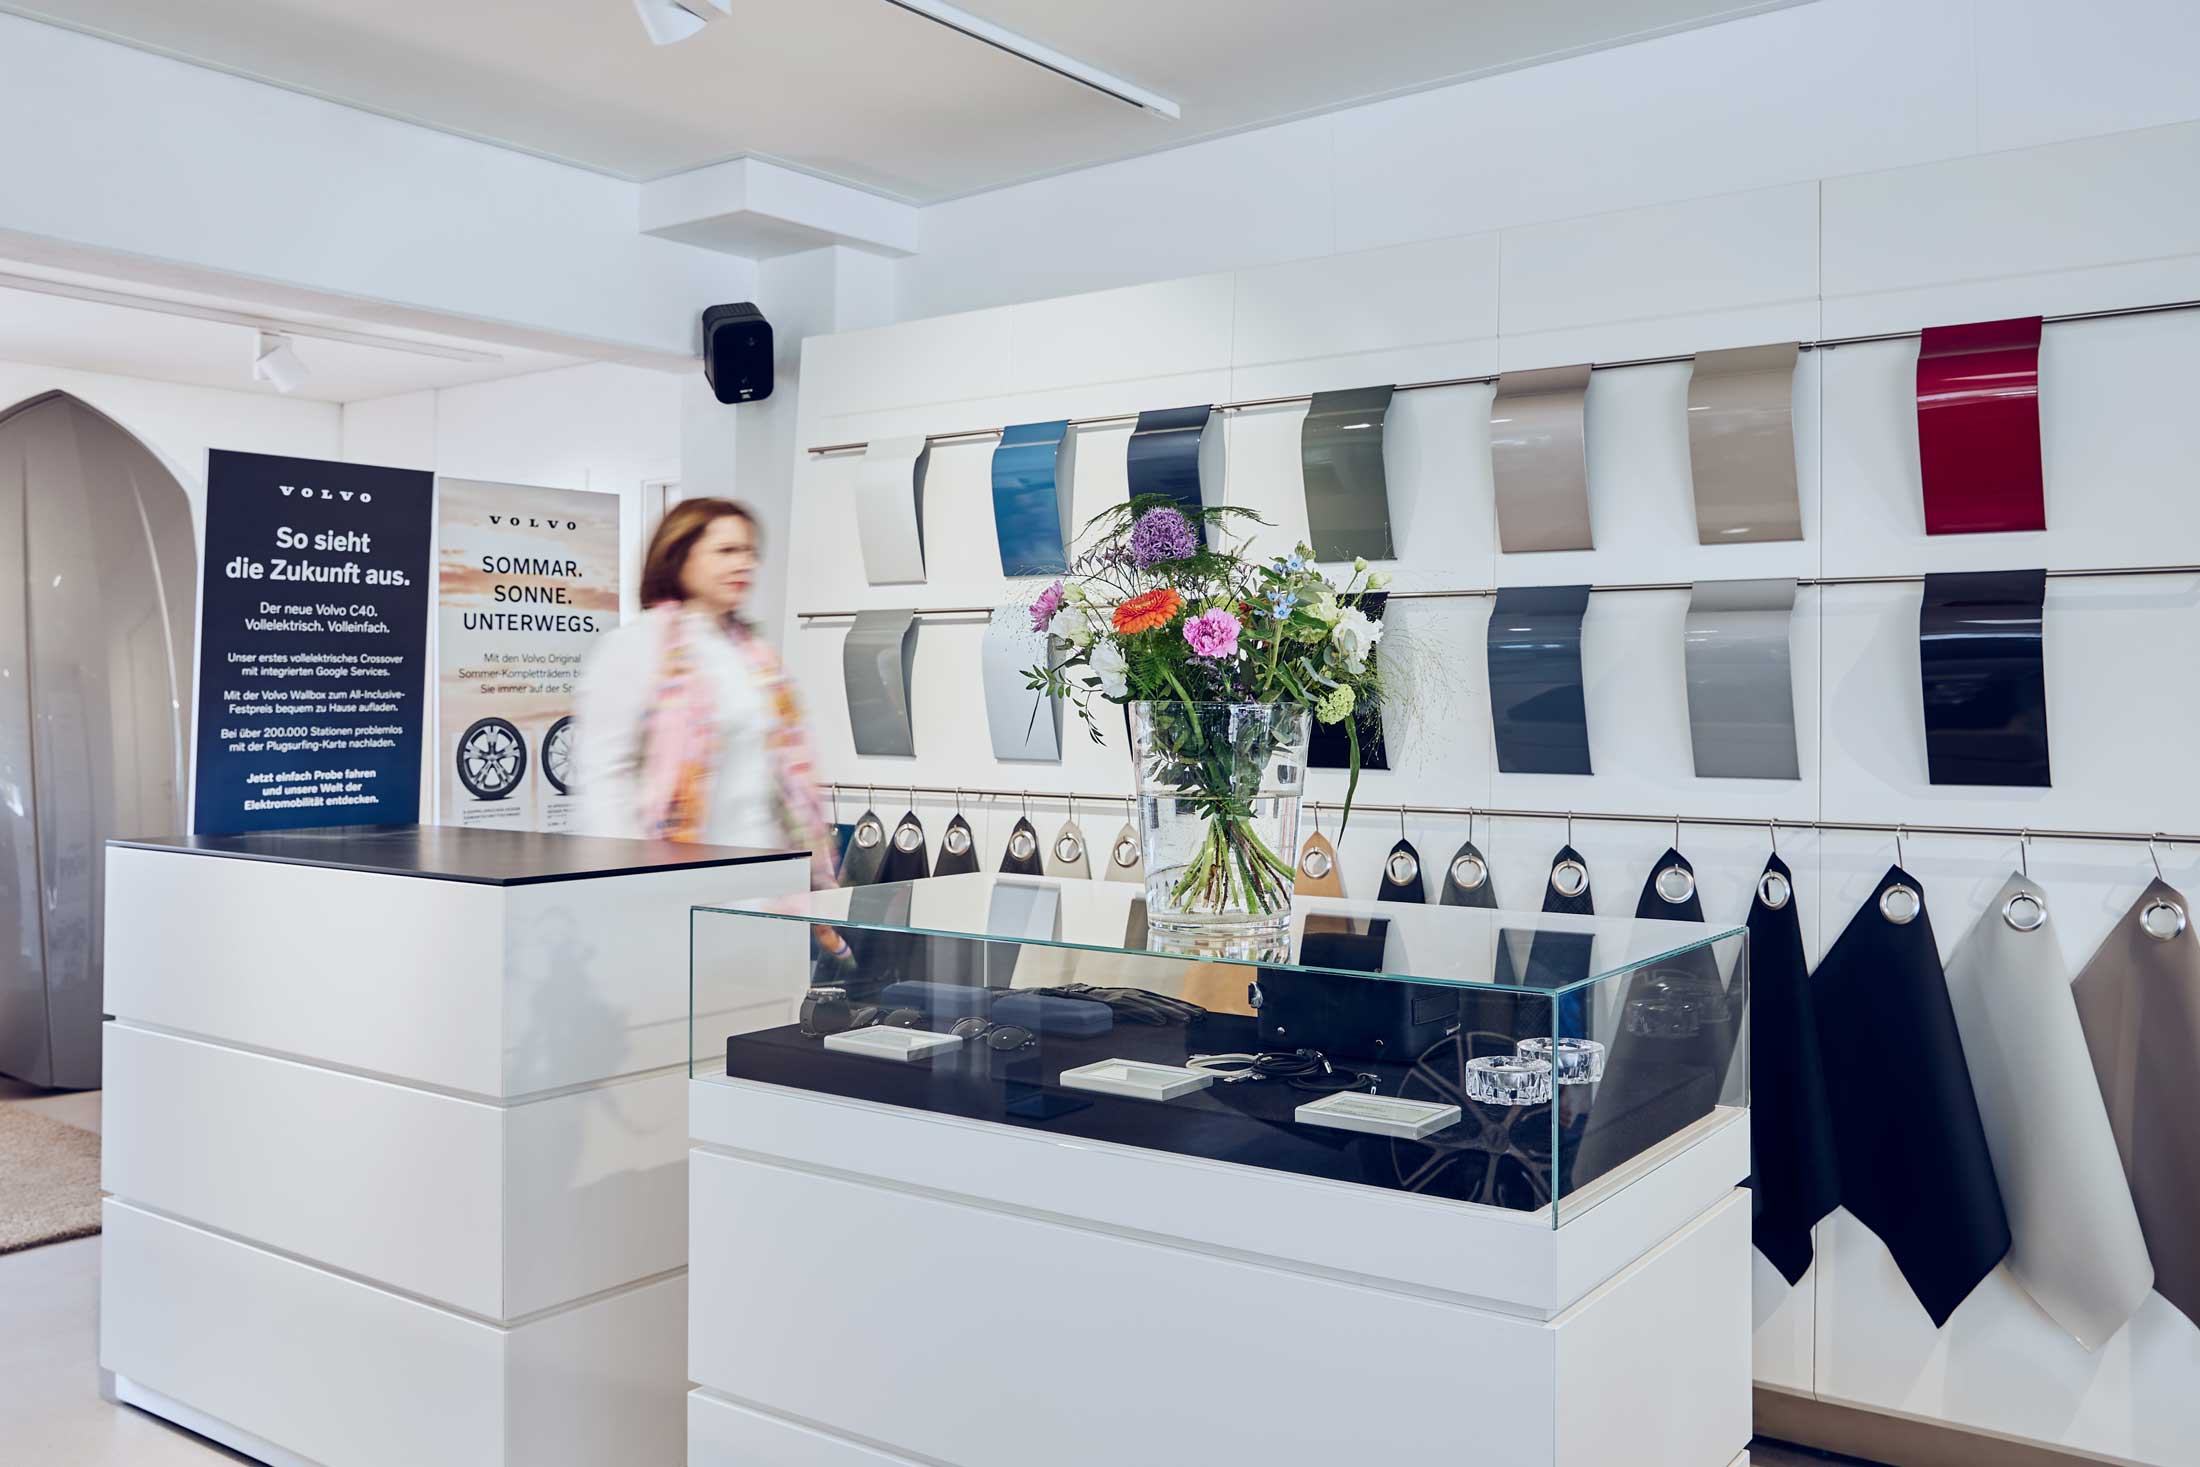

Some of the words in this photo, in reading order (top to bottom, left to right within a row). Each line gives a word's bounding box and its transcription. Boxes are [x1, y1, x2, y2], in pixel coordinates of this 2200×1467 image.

[279, 485, 372, 503] VOLVO
[489, 515, 576, 530] VOLVO
[276, 526, 308, 549] So
[314, 530, 371, 553] sieht
[225, 557, 264, 579] die
[269, 559, 361, 584] Zukunft
[365, 569, 410, 586] aus.
[482, 556, 583, 577] SOMMAR.
[494, 585, 572, 604] SONNE.
[260, 602, 281, 614] Der
[284, 605, 312, 614] neue
[316, 604, 346, 616] Volvo
[350, 605, 378, 617] C40.
[245, 619, 324, 632] Vollelektrisch.
[328, 621, 390, 633] Volleinfach.
[463, 613, 600, 632] UNTERWEGS.
[228, 653, 256, 663] Unser
[258, 653, 287, 663] erstes
[290, 653, 358, 663] vollelektrisches
[360, 654, 403, 663] Crossover
[484, 654, 499, 663] Mit
[502, 654, 519, 663] den
[521, 654, 545, 663] Volvo
[548, 654, 581, 665] Original
[242, 667, 257, 676] mit
[261, 667, 313, 678] integrierten
[316, 667, 348, 678] Google
[351, 667, 390, 676] Services.
[224, 691, 241, 700] Mit
[243, 690, 259, 699] der
[262, 691, 287, 700] Volvo
[290, 691, 326, 699] Wallbox
[349, 690, 405, 699] All-Inclusive-
[481, 684, 495, 694] Sie
[498, 685, 527, 693] immer
[529, 684, 543, 693] auf
[545, 684, 559, 693] der
[229, 704, 273, 714] Festpreis
[276, 704, 313, 714] bequem
[329, 703, 356, 712] Hause
[359, 703, 398, 712] aufladen.
[221, 729, 237, 738] Bei
[240, 728, 262, 738] über
[264, 727, 308, 737] 200.000
[310, 726, 352, 737] Stationen
[355, 725, 403, 736] problemlos
[229, 742, 245, 752] mit
[247, 742, 263, 751] der
[266, 739, 346, 752] Plugsurfing-Karte
[349, 739, 395, 748] nachladen.
[247, 773, 274, 783] Jetzt
[276, 772, 311, 782] einfach
[314, 770, 343, 781] Probe
[345, 769, 376, 779] fahren
[262, 786, 282, 795] und
[285, 785, 318, 794] unsere
[320, 783, 344, 793] Welt
[345, 783, 362, 791] der
[244, 797, 323, 810] Elektromobilität
[326, 795, 378, 805] entdecken.
